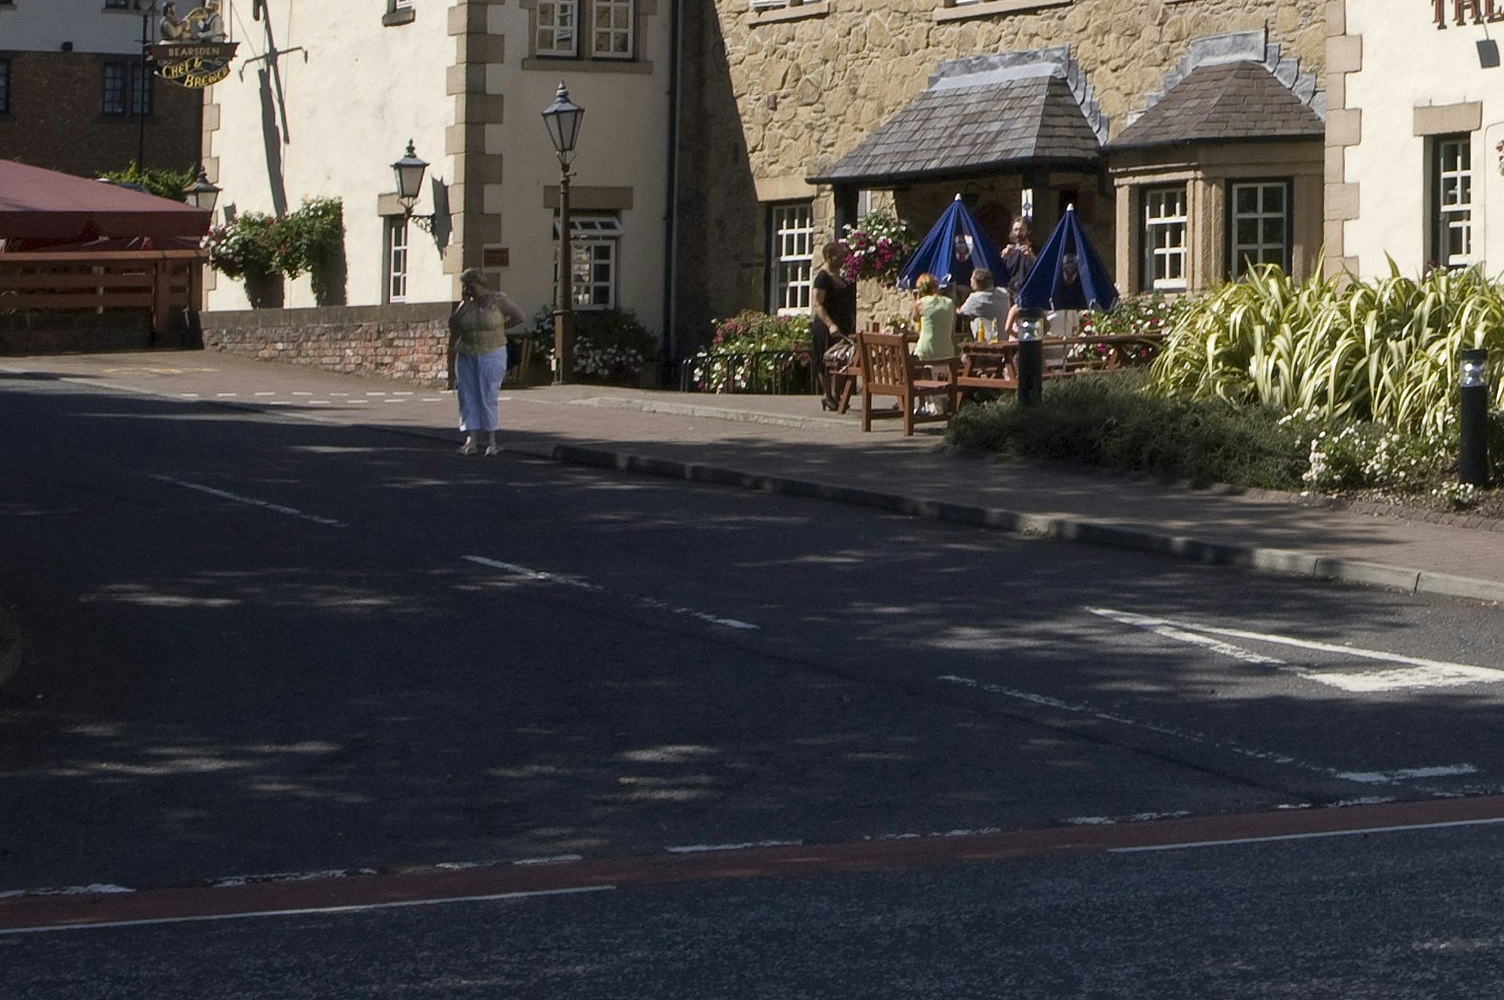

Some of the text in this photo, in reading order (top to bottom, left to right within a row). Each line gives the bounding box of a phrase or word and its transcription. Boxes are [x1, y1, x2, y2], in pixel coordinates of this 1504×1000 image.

[168, 46, 220, 57] BEARSDEN
[162, 57, 202, 78] CHEF &
[184, 66, 229, 87] BREWER
